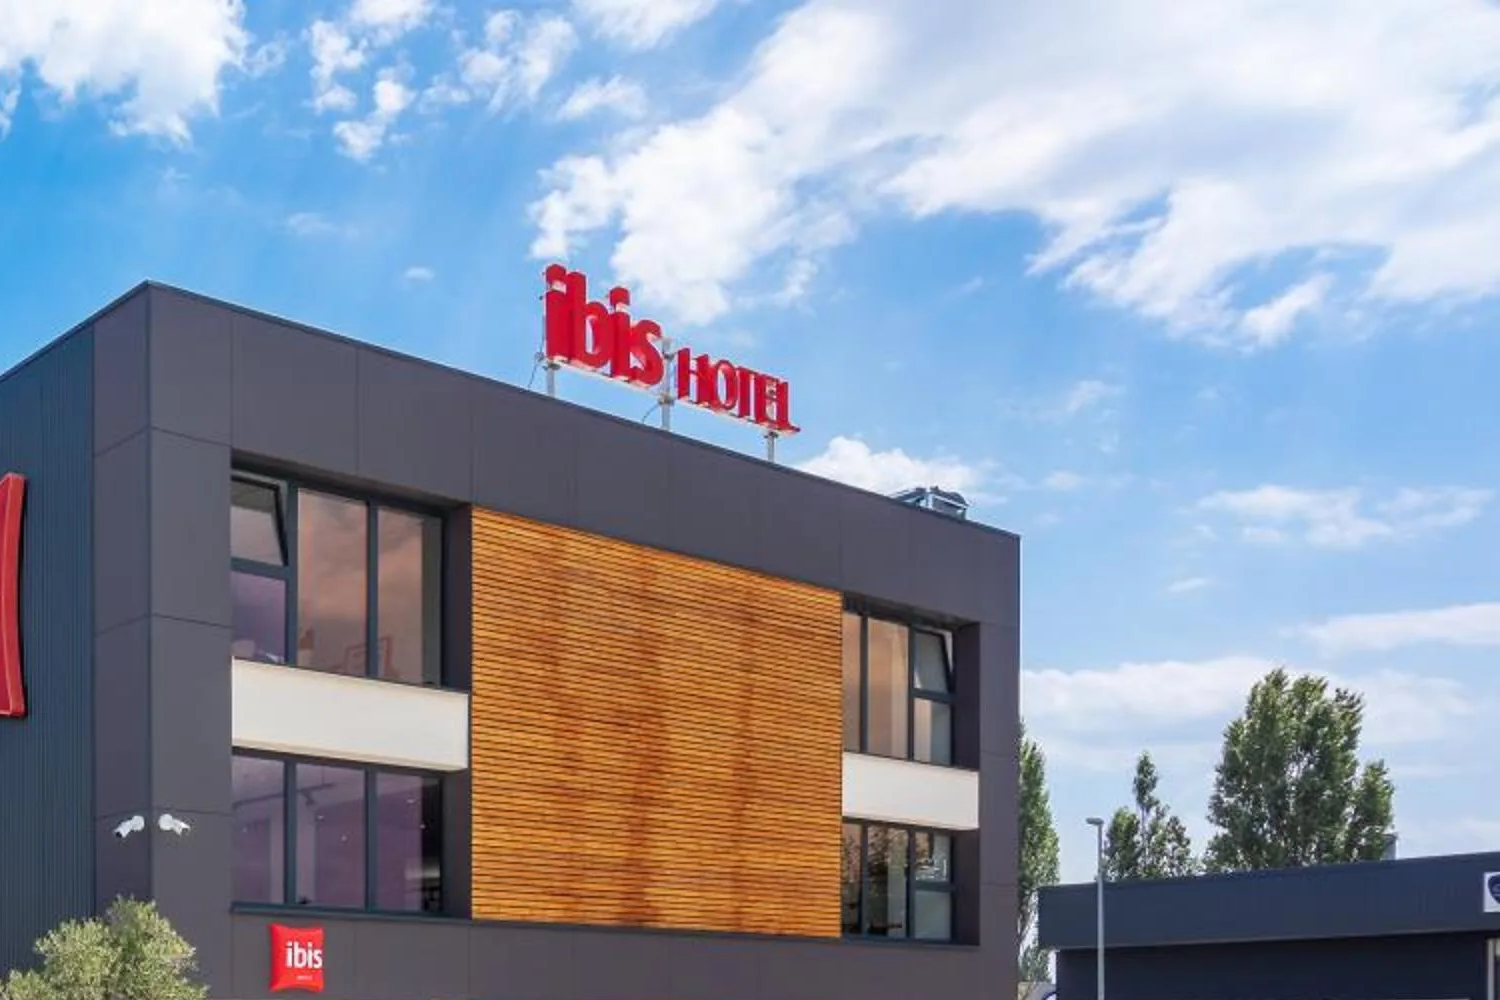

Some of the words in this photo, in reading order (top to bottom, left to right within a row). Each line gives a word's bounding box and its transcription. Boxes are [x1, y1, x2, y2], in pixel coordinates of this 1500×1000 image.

[545, 264, 664, 386] ibis
[677, 348, 800, 433] HOTEL
[286, 941, 323, 969] ibis
